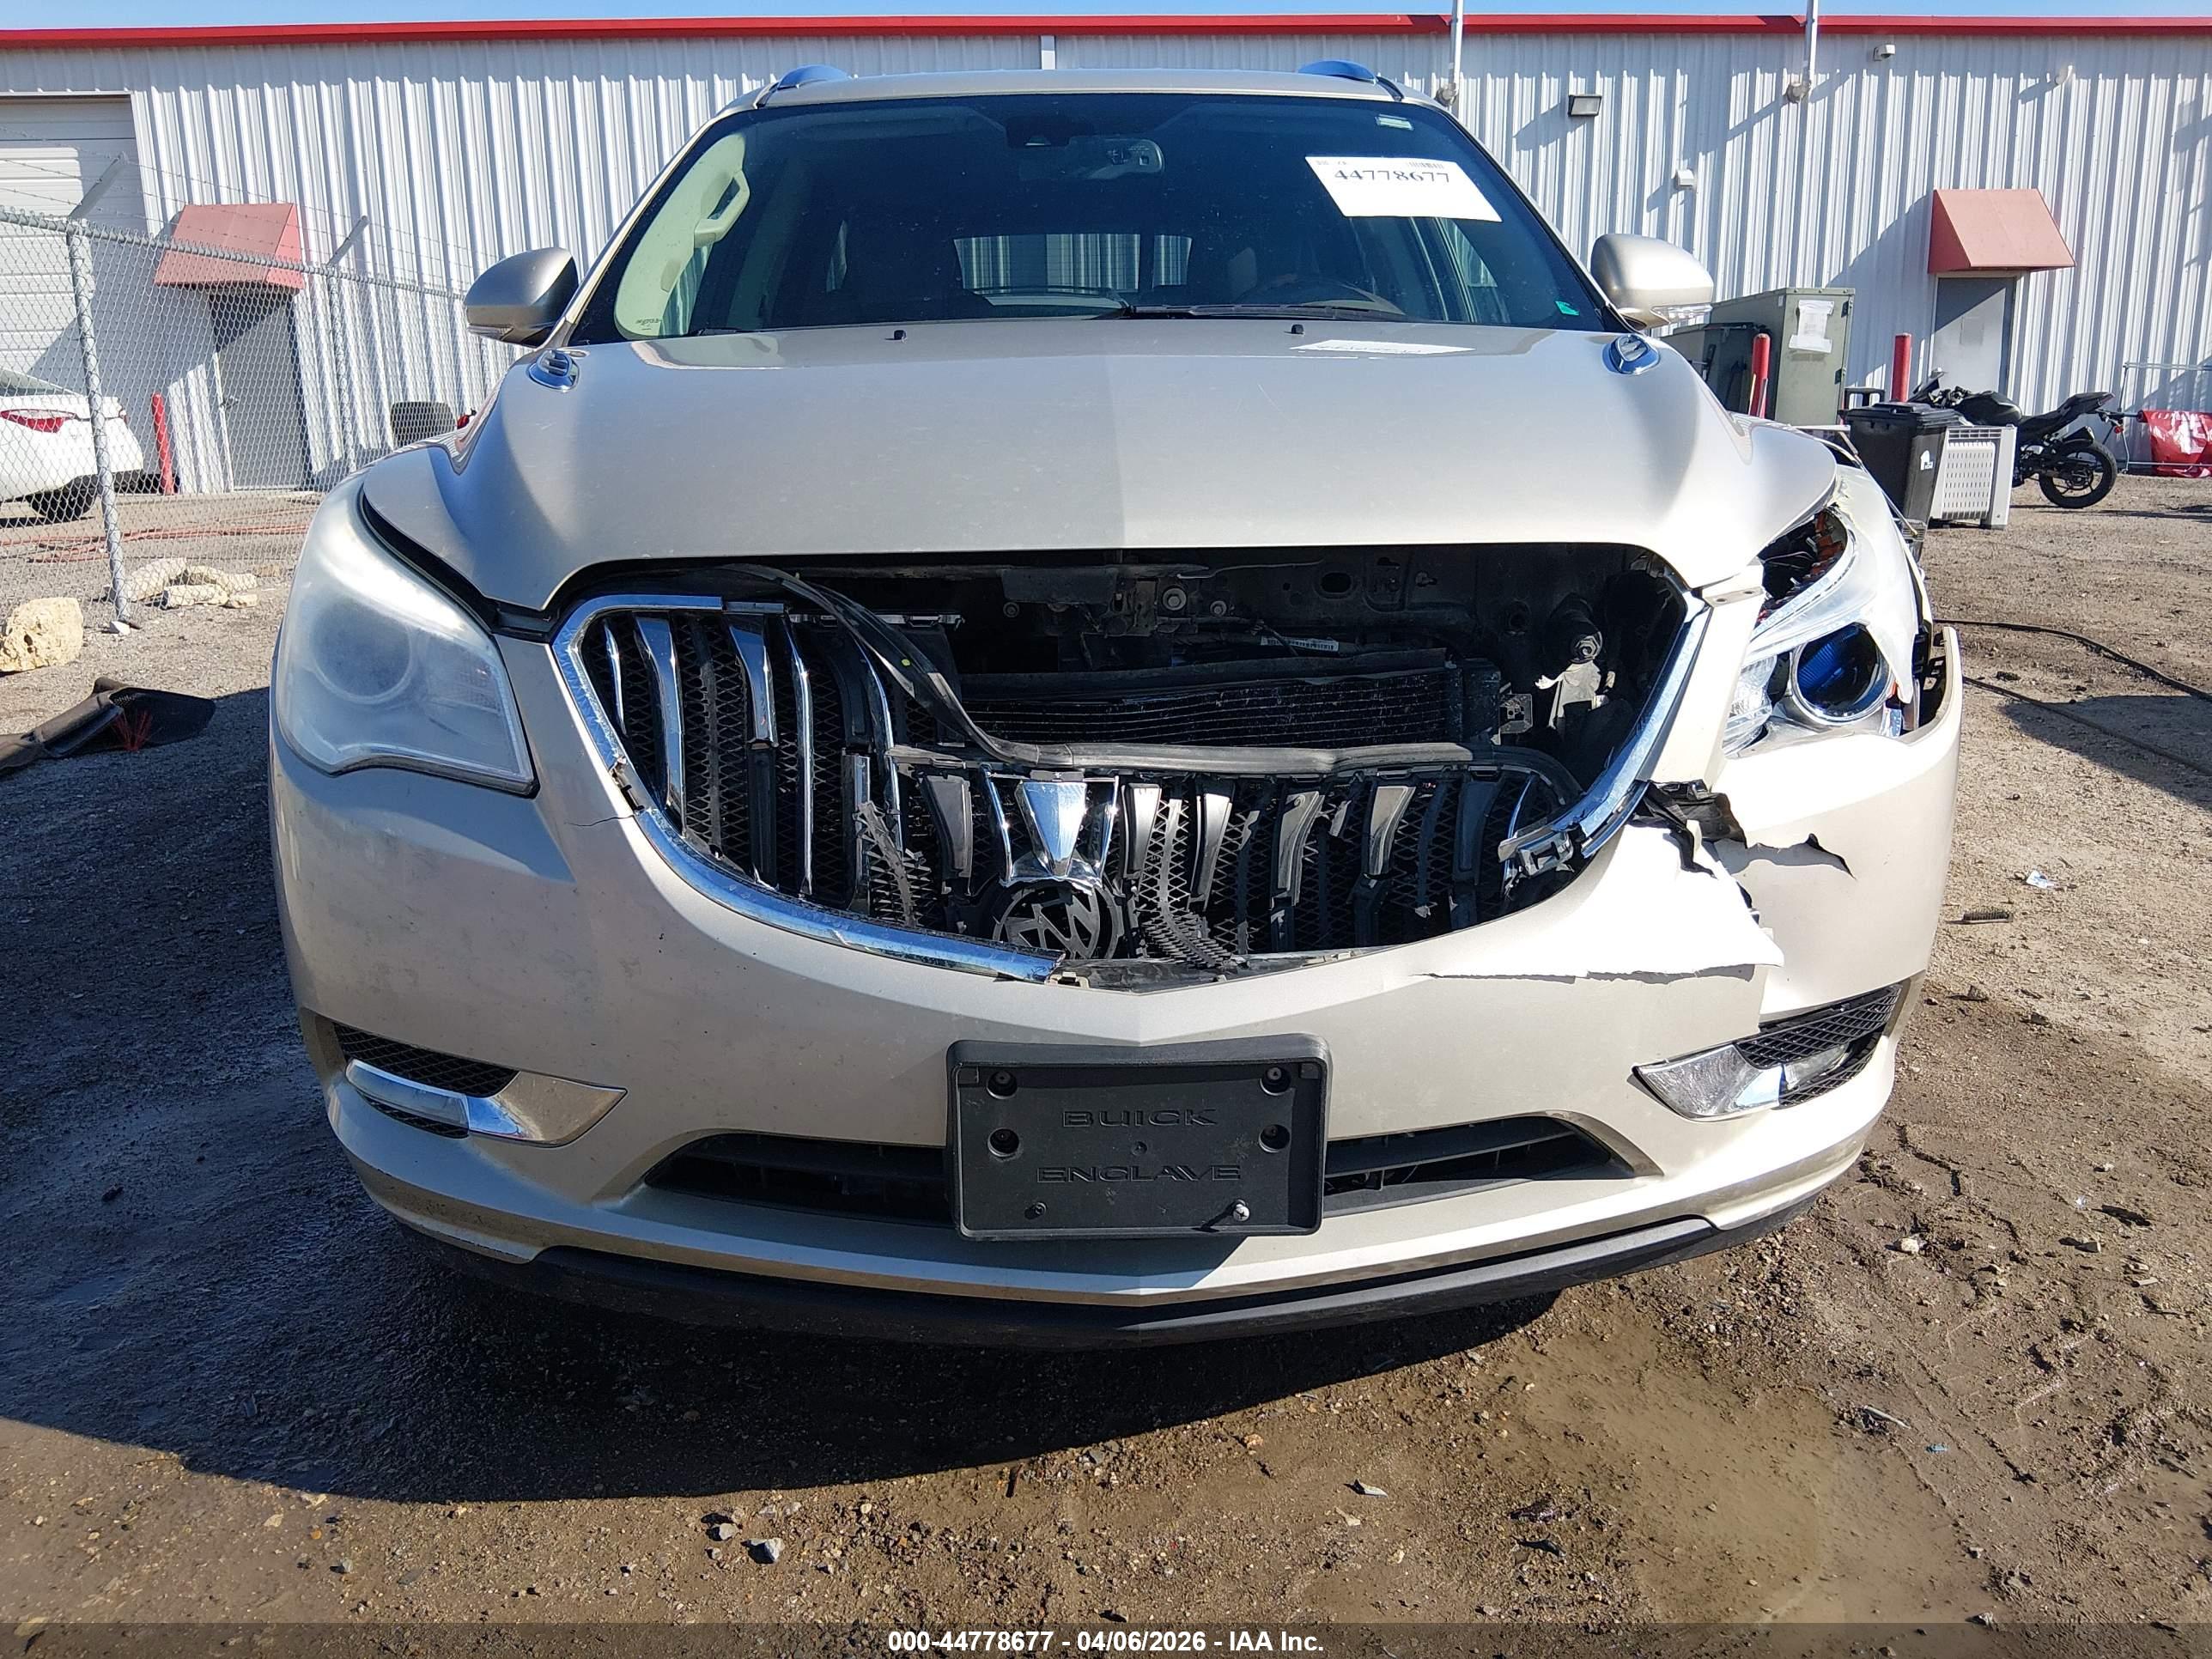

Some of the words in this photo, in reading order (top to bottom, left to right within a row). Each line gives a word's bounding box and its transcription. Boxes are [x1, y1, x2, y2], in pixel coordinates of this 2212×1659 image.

[1334, 169, 1449, 183] 44778677
[1062, 1109, 1218, 1127] BUICK
[1036, 1164, 1242, 1183] ENCLAVE
